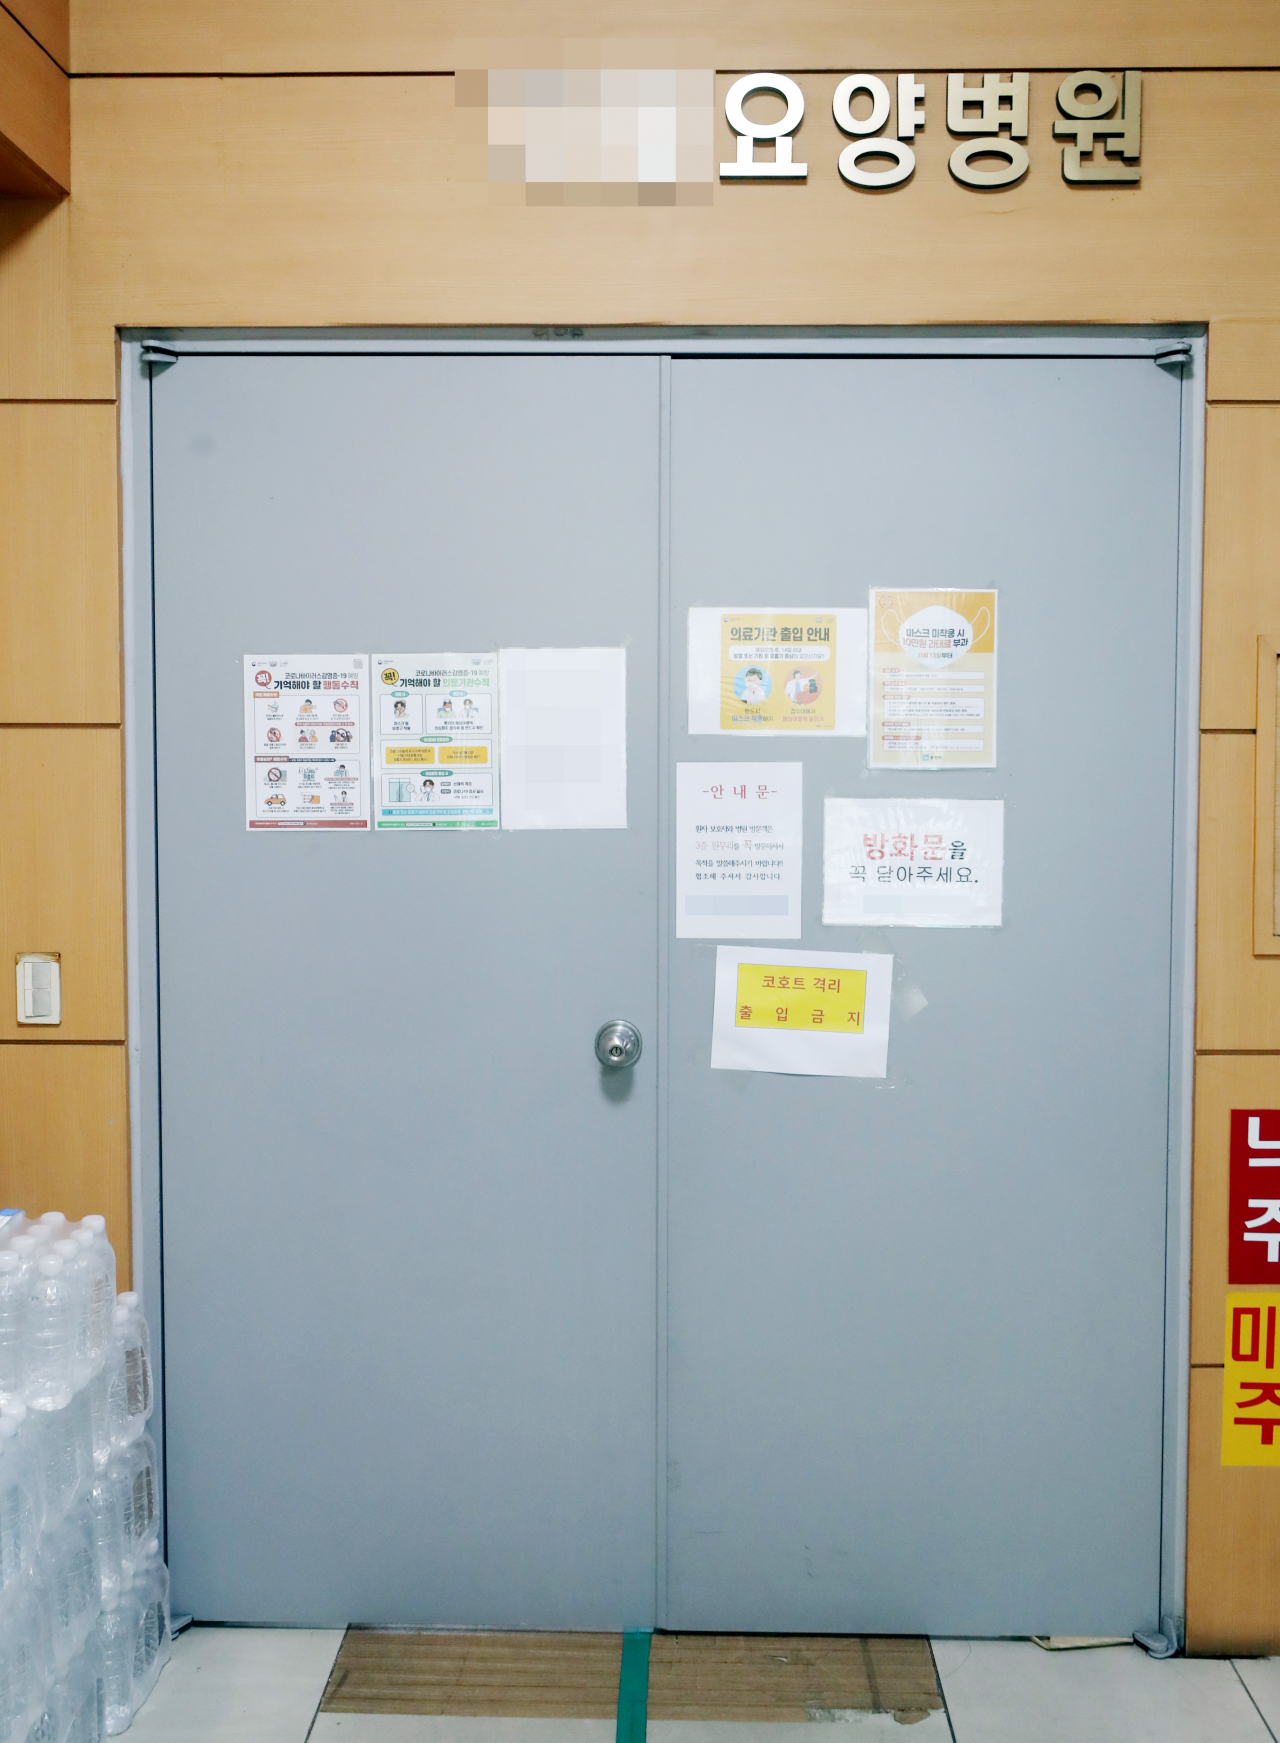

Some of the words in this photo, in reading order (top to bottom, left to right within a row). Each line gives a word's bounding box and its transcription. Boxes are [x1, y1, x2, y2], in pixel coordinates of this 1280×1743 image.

[719, 70, 1142, 189] 요양병원
[730, 627, 777, 642] 의료기관
[780, 627, 803, 642] 출입
[807, 627, 830, 642] 안내
[906, 629, 930, 637] 마스크
[932, 629, 955, 638] 미착용
[957, 629, 965, 637] 시
[902, 638, 926, 648] 10만원
[928, 639, 951, 648] 과태료
[953, 638, 968, 647] 부과
[383, 671, 396, 681] 꼭!
[274, 680, 310, 690] 기억해야
[312, 680, 321, 690] 할
[323, 680, 359, 690] 행동수칙
[400, 678, 430, 687] 기억해야
[433, 678, 441, 687] 할
[443, 678, 490, 687] 의료기관수칙
[732, 715, 750, 723] 마스크
[733, 784, 746, 800] 내
[695, 841, 708, 850] 3층
[742, 839, 753, 851] 꼭
[863, 833, 967, 861] 방화문을
[745, 873, 783, 881] 감사합니다.
[849, 865, 867, 883] 꼭
[877, 866, 979, 884] 닫아주세요.
[762, 975, 806, 990] 코호트
[813, 977, 841, 994] 격리
[739, 1005, 753, 1020] 출
[776, 1007, 788, 1022] 입
[811, 1009, 825, 1024] 금
[847, 1011, 860, 1026] 지
